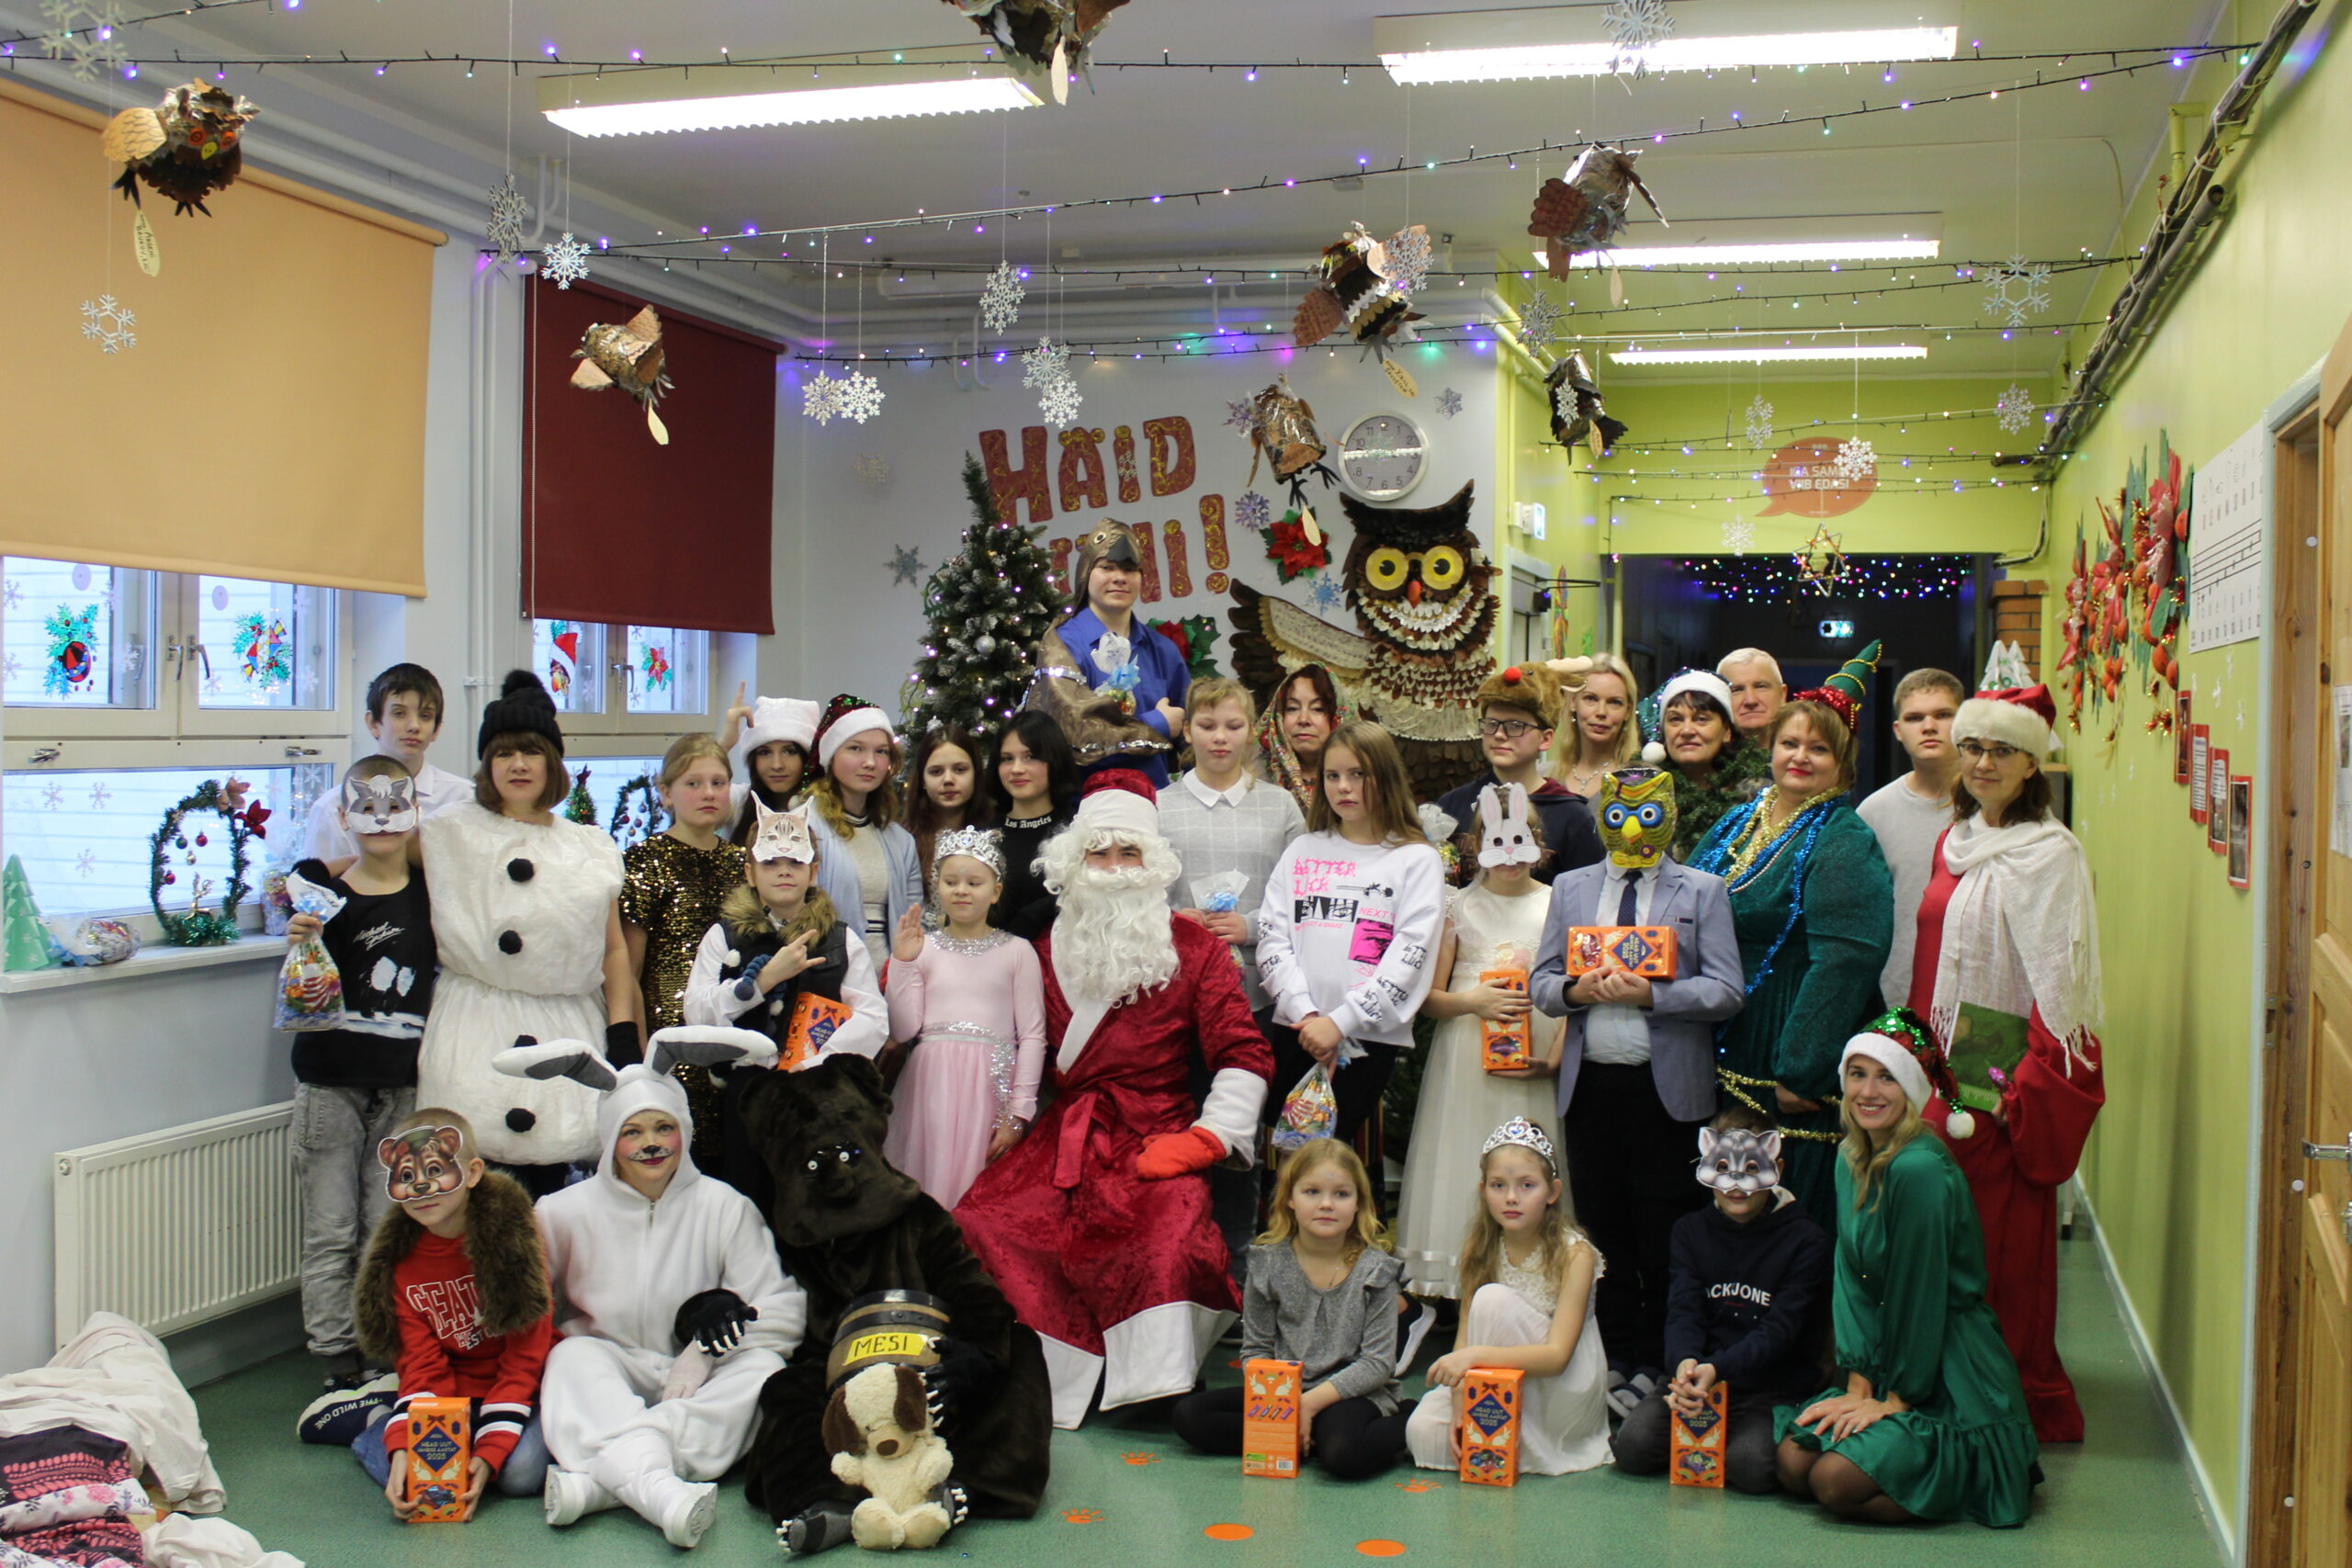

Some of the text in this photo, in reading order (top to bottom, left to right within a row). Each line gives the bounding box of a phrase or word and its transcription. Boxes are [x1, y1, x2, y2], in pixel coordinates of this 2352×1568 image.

[1789, 467, 1808, 477] IA
[1005, 816, 1052, 829] Los Angeles
[1359, 907, 1389, 919] NEXT
[1705, 1282, 1771, 1307] CKJONE
[854, 1335, 909, 1358] MESI
[332, 1402, 357, 1417] WILD
[314, 1413, 332, 1430] ONE
